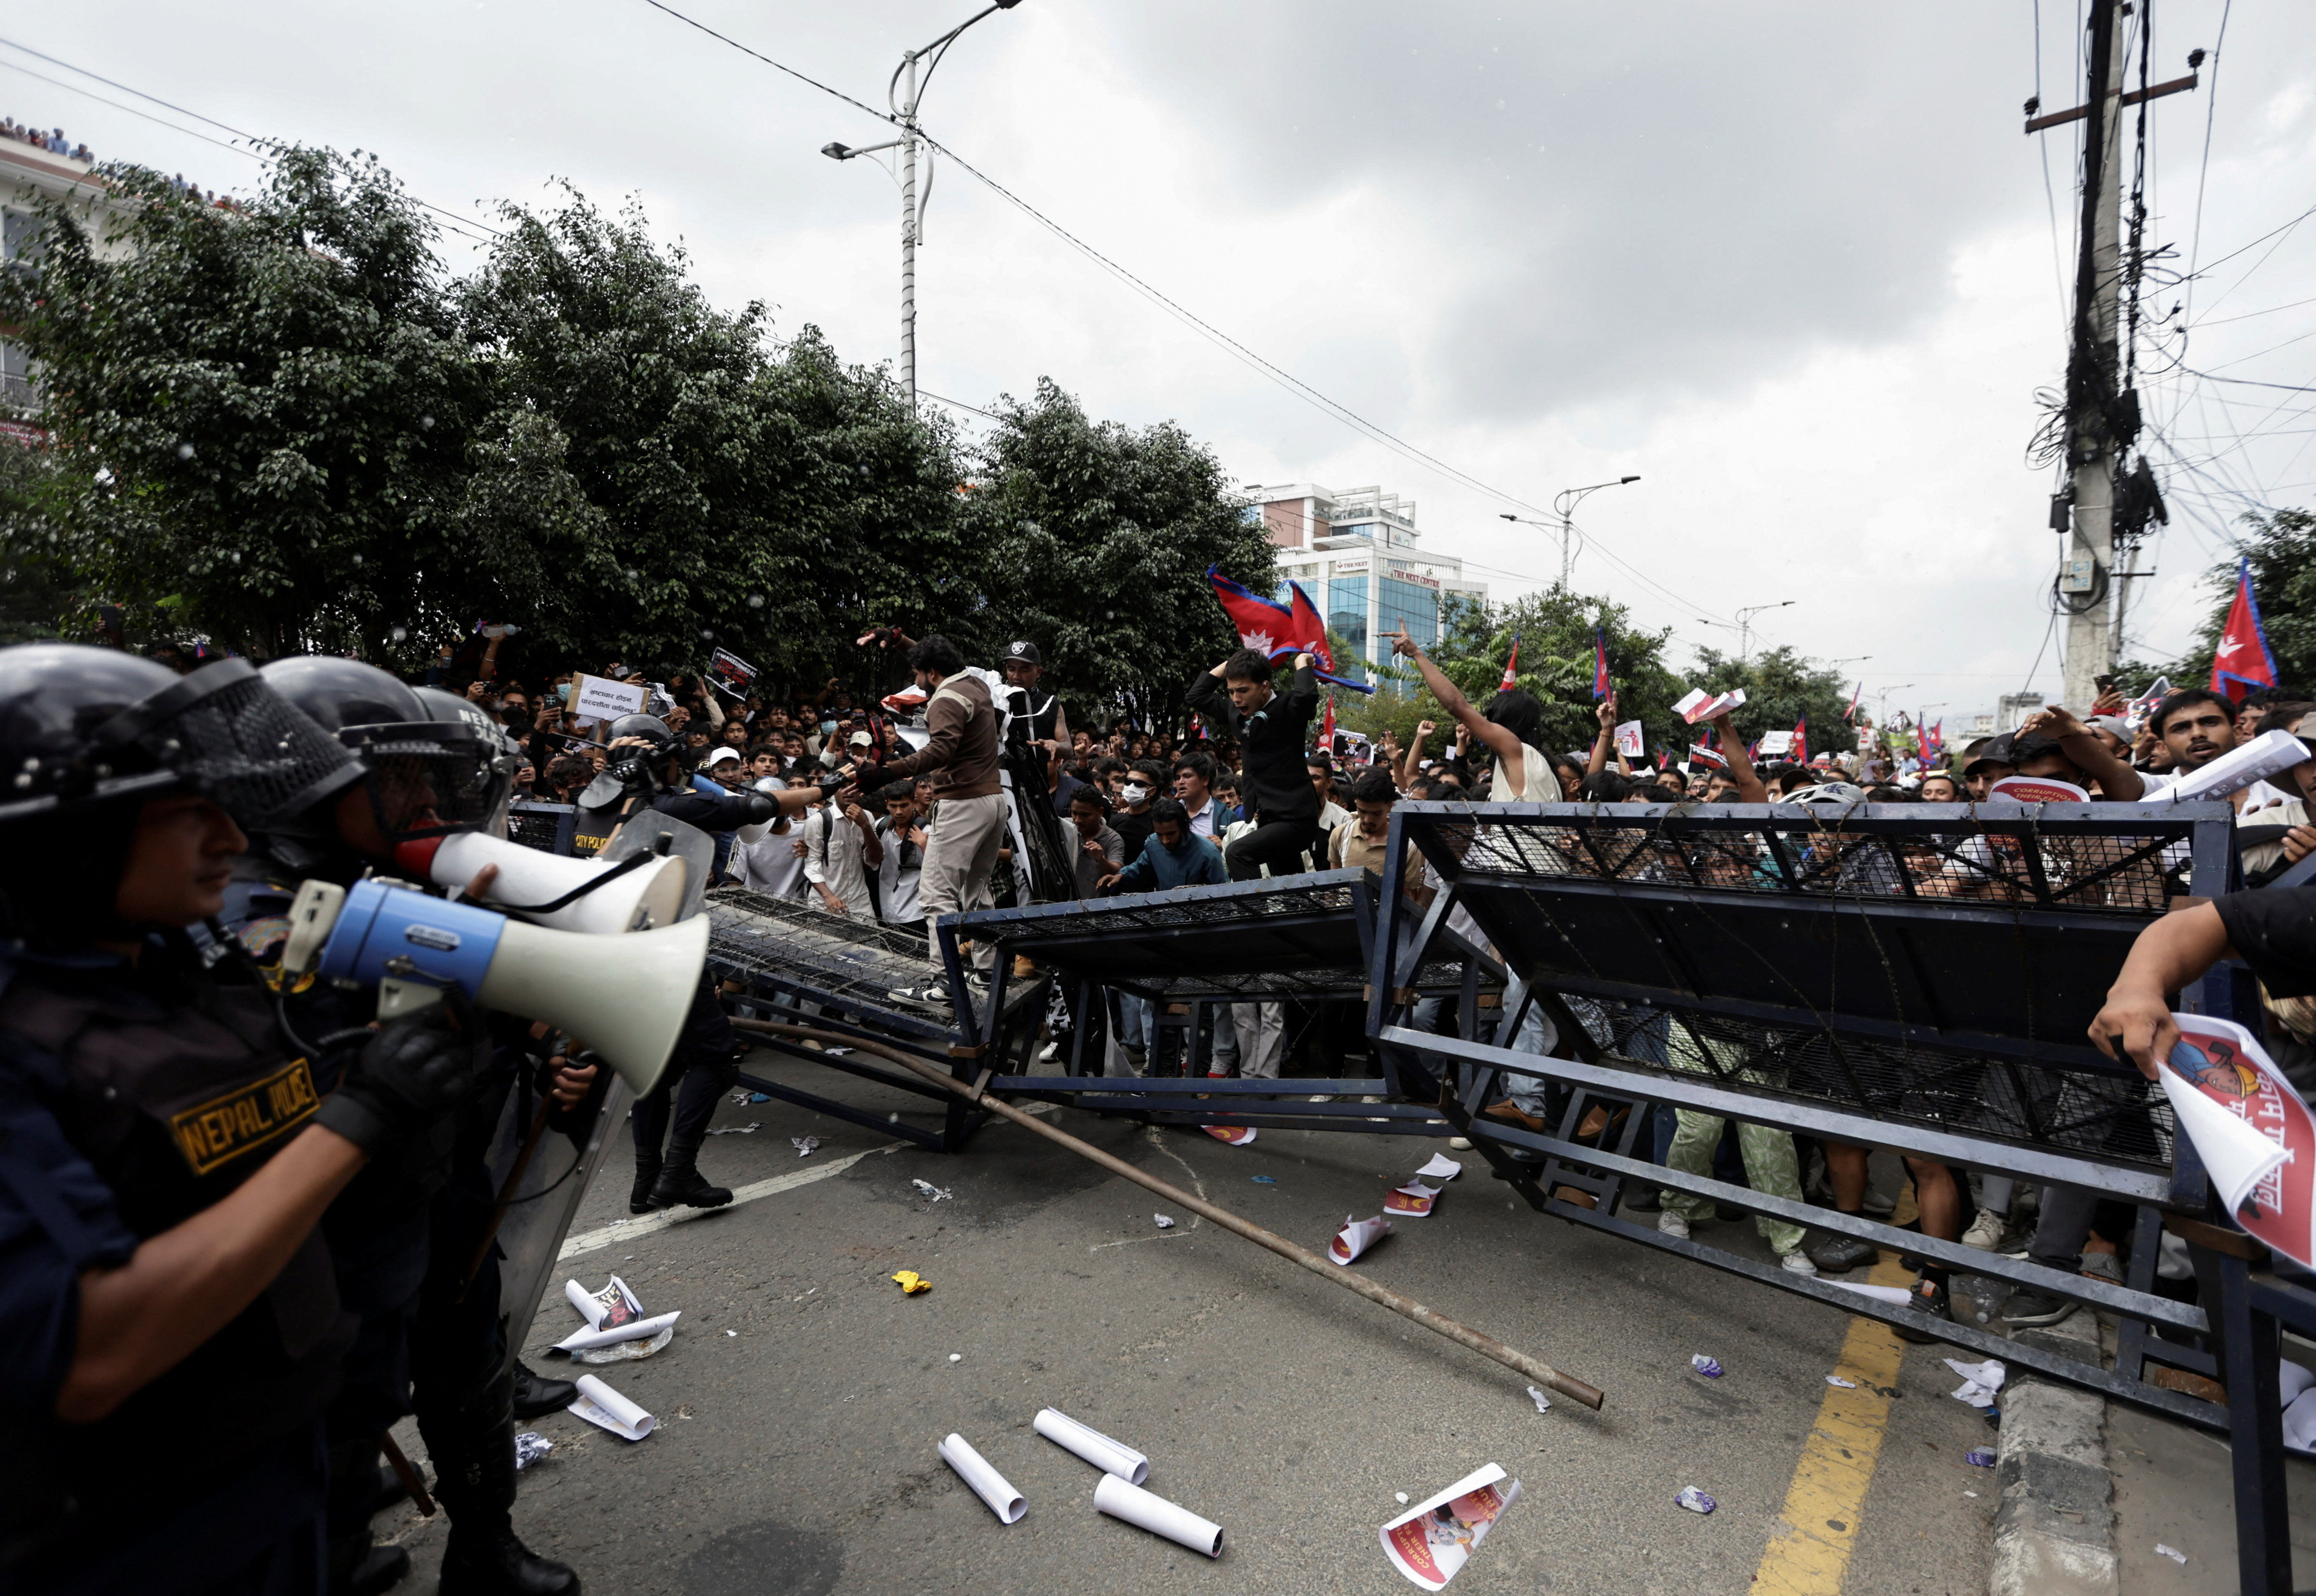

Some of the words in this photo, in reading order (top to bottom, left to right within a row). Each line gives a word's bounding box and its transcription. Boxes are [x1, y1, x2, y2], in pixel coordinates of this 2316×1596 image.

[1393, 569, 1404, 579] THE
[1406, 572, 1419, 583] NEXT
[1420, 576, 1440, 588] CENTRE
[576, 835, 588, 848] CITY
[2256, 1071, 2285, 1122] काम
[184, 1095, 274, 1158] NEPAL
[600, 1285, 616, 1301] UP
[601, 1289, 621, 1307] AL!
[1403, 1523, 1413, 1536] FE
[1395, 1527, 1430, 1569] CORRUPTI
[1411, 1535, 1431, 1560] THEIR
